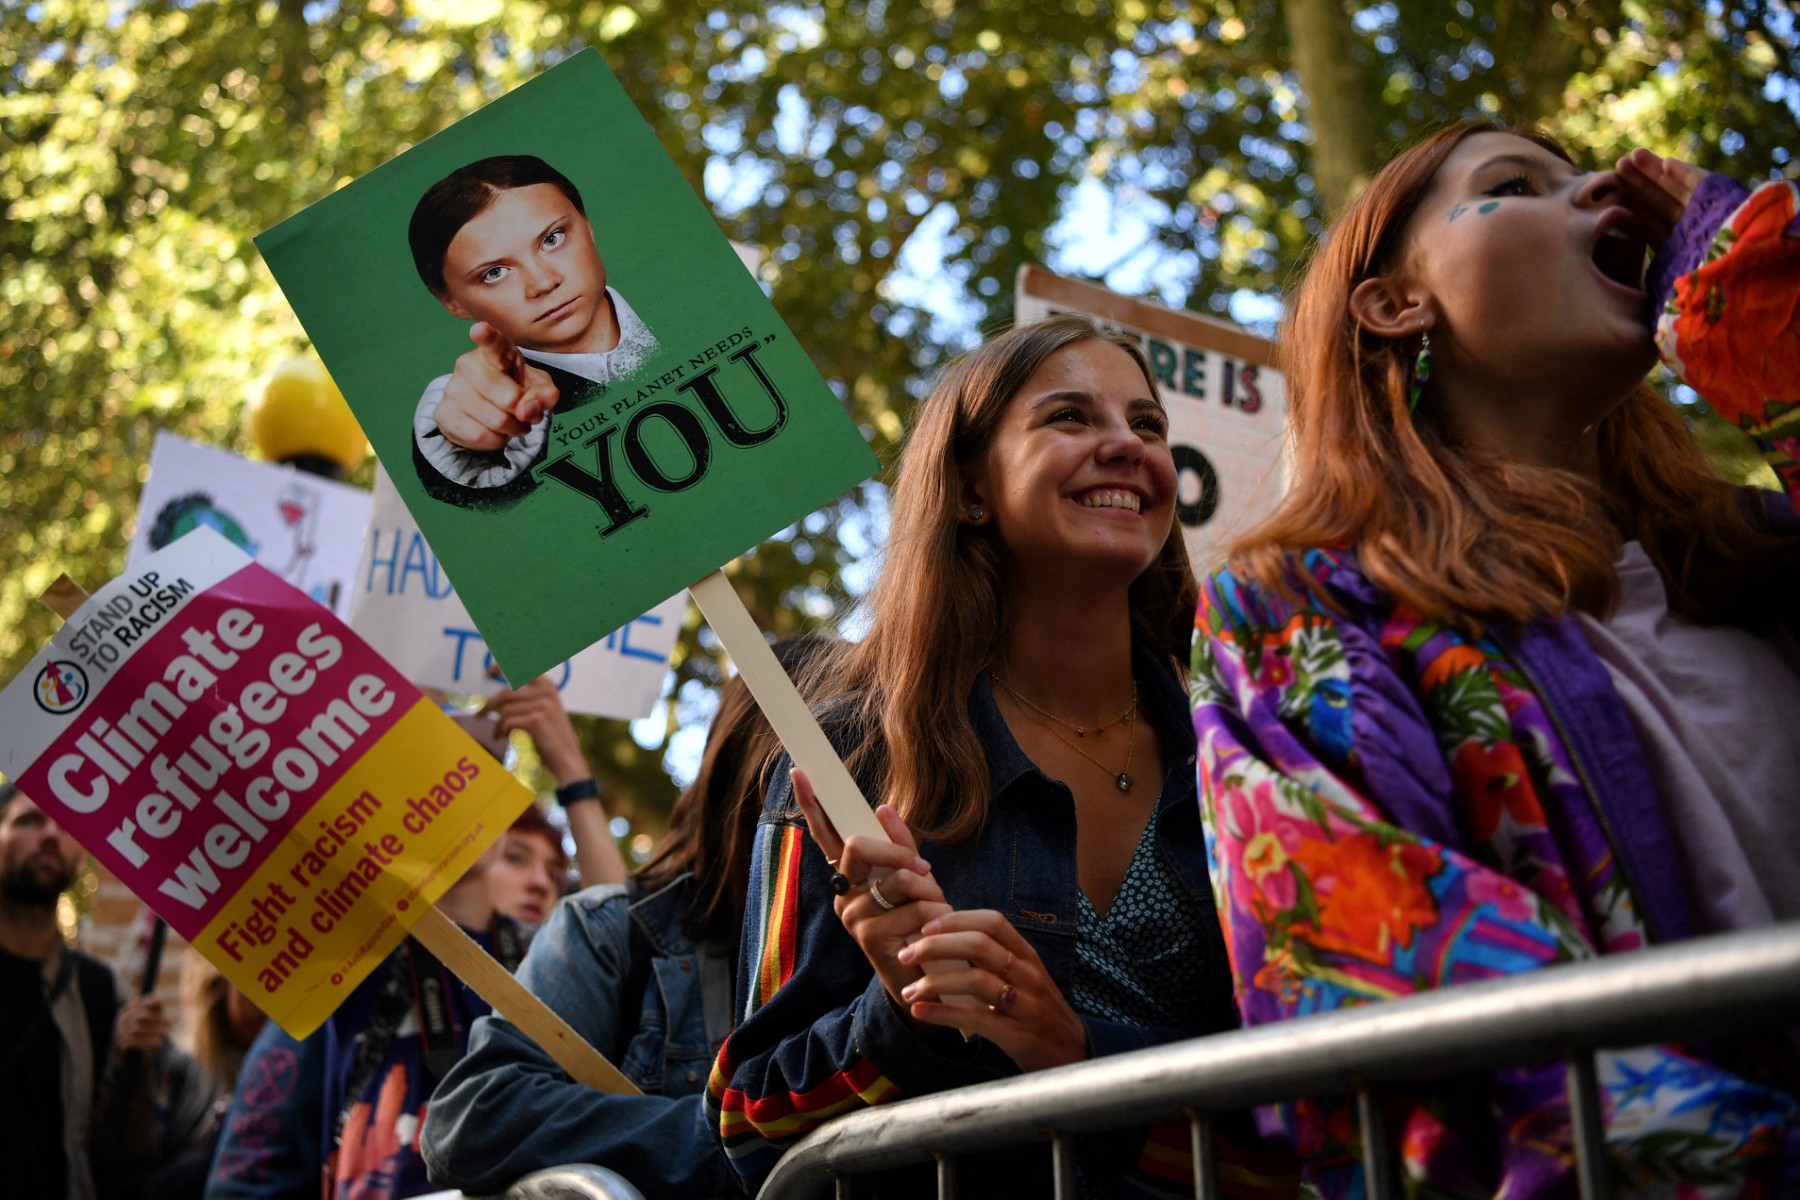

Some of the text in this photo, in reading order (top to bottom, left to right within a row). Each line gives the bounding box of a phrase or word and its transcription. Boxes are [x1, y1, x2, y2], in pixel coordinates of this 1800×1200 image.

[611, 365, 685, 416] PLANET
[689, 325, 753, 370] NEEDS
[1221, 359, 1263, 414] IS
[69, 571, 160, 659] STAND UP
[87, 577, 195, 674] TO RACISM
[48, 607, 264, 815] Climate
[106, 622, 343, 870] refugees
[158, 672, 396, 911] welcome
[216, 788, 384, 964] Fight racism
[257, 754, 481, 994] and climate chaos
